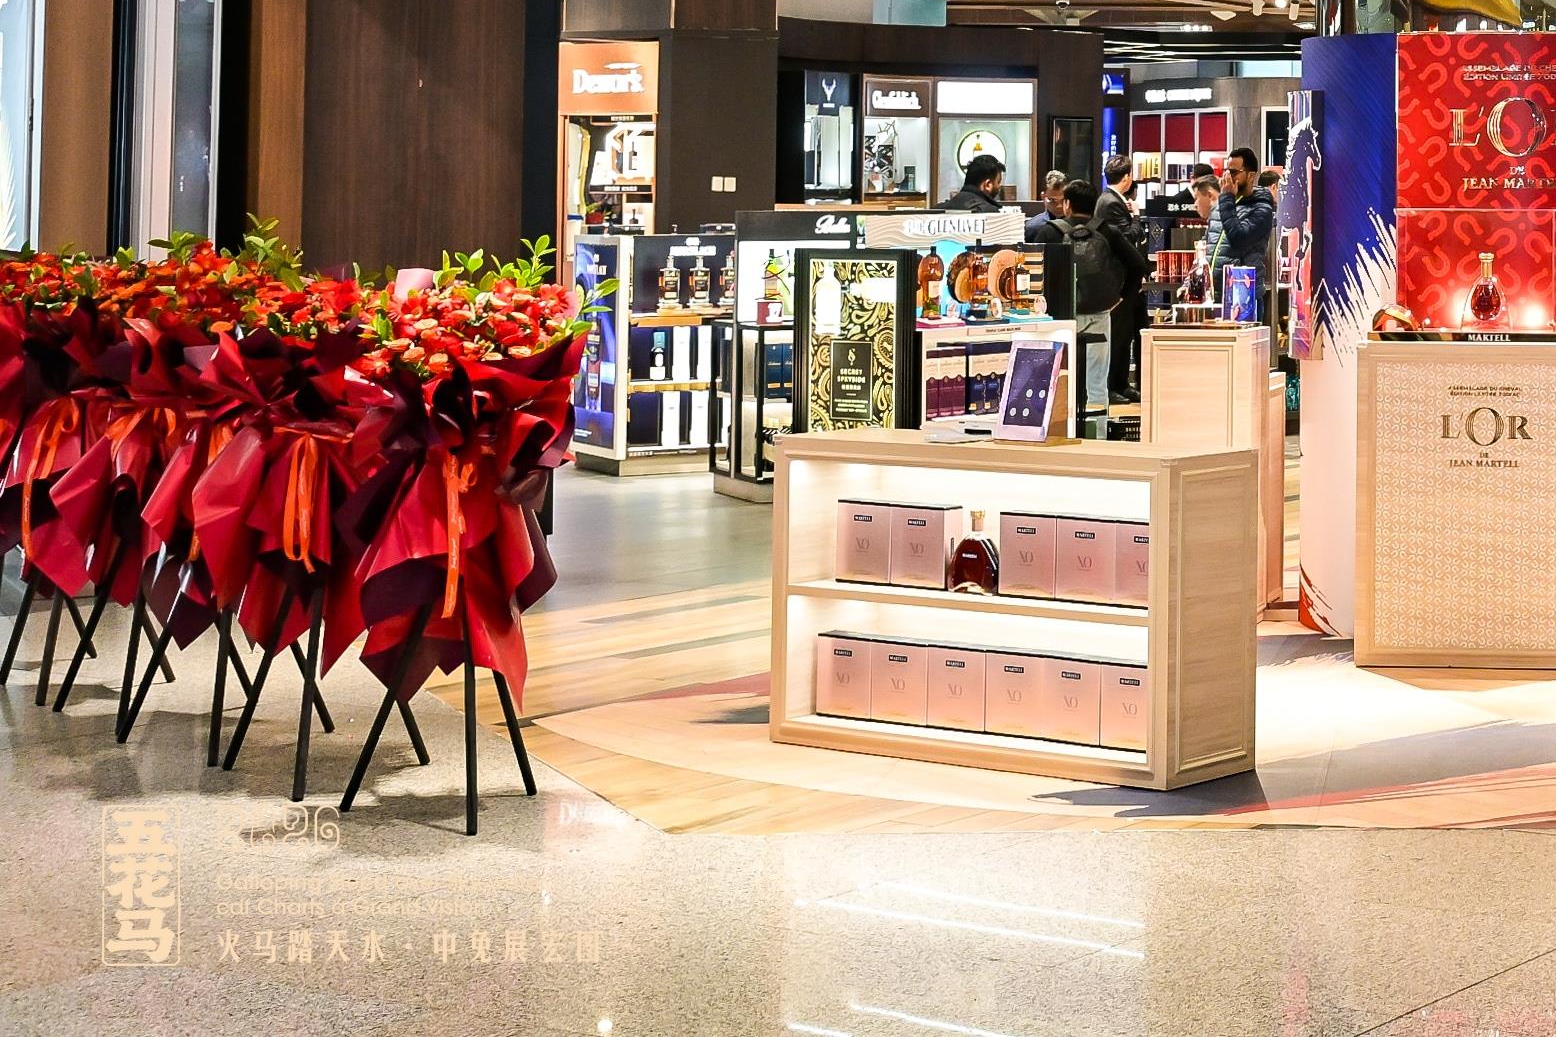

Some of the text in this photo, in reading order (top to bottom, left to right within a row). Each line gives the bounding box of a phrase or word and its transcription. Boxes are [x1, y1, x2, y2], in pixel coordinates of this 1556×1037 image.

[1467, 334, 1511, 342] MARTELL
[1440, 407, 1533, 446] L'OR
[1449, 460, 1519, 468] JEAN MARTELL
